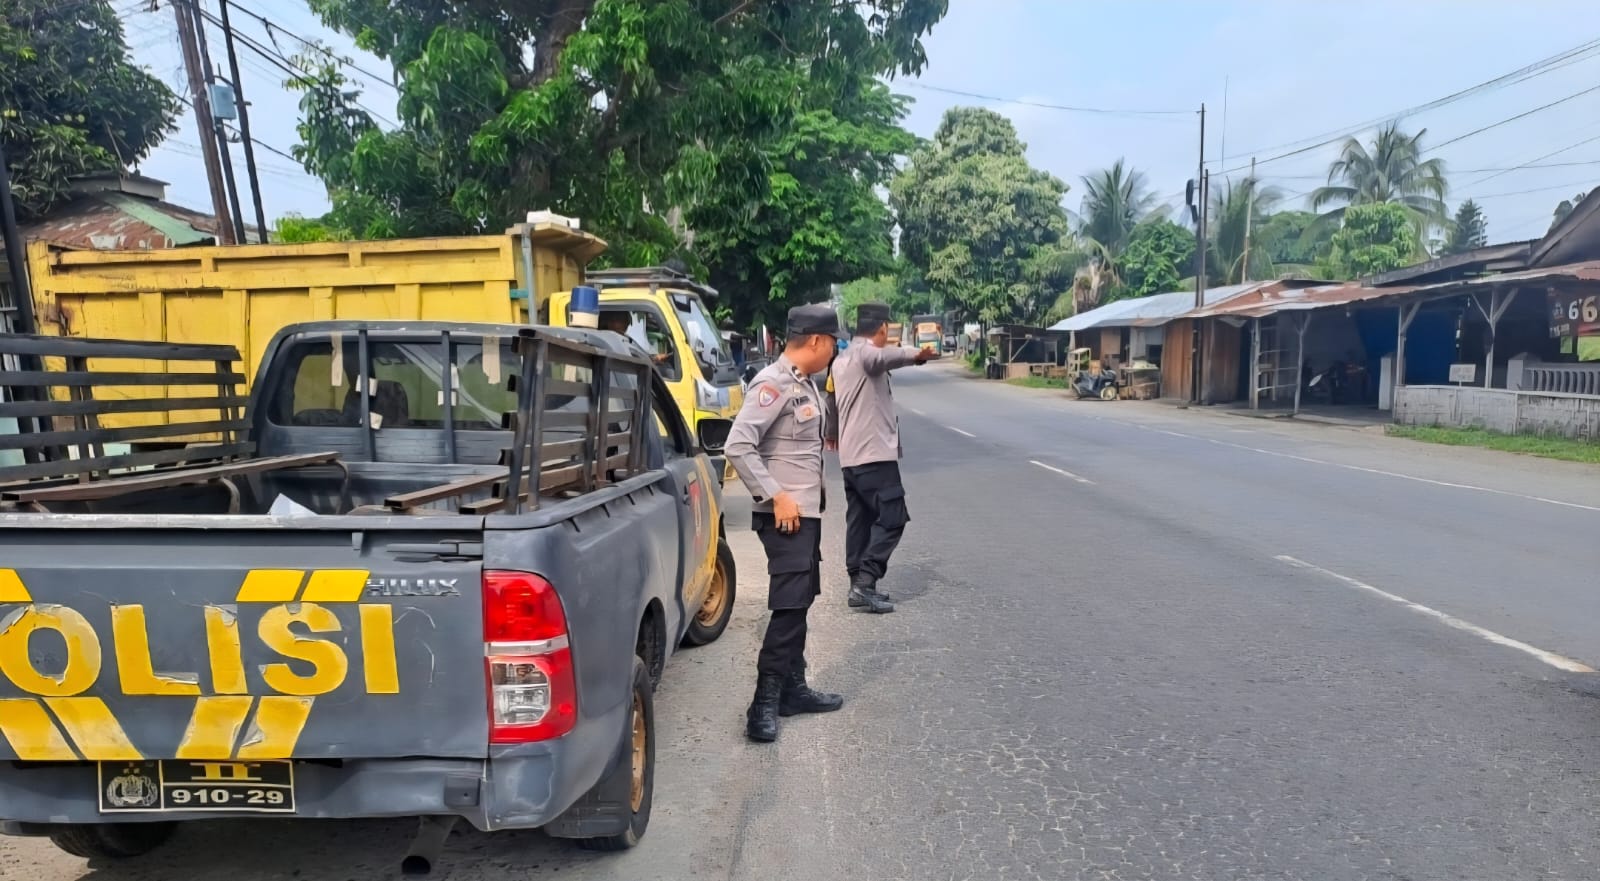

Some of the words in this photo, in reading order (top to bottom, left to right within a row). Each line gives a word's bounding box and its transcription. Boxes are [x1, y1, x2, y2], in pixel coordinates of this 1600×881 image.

[365, 578, 461, 597] HILUX
[0, 602, 399, 697] OLISI
[172, 789, 284, 804] 910-29
